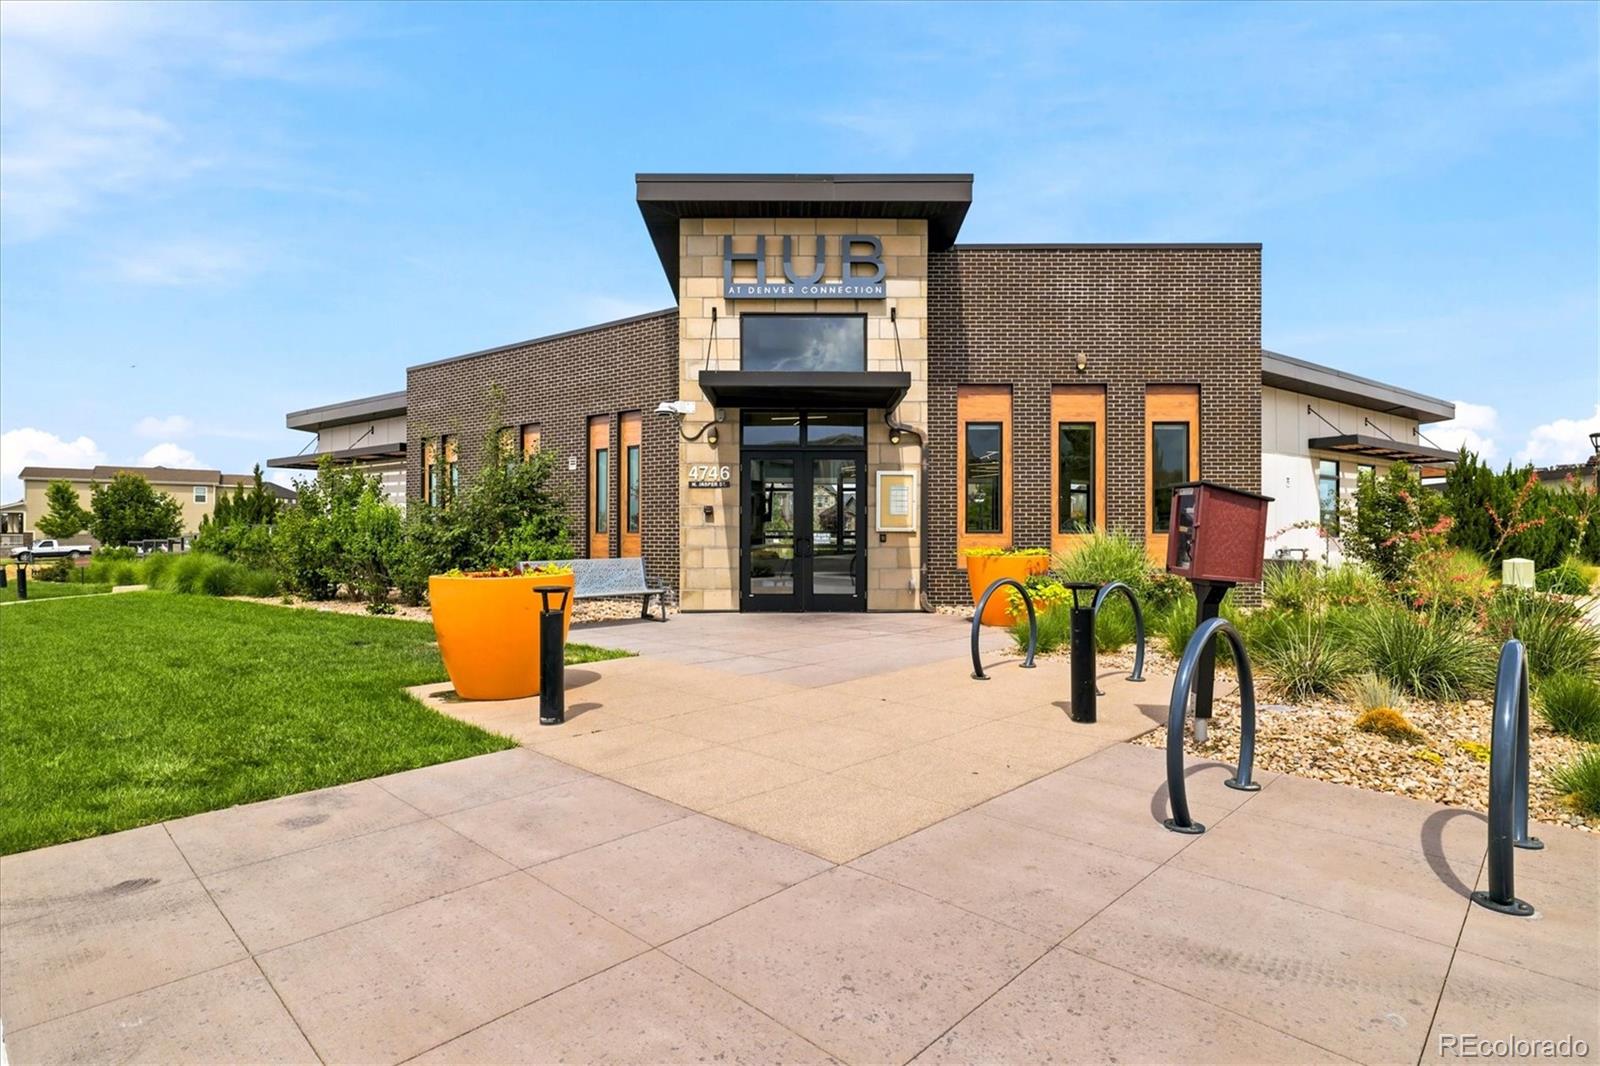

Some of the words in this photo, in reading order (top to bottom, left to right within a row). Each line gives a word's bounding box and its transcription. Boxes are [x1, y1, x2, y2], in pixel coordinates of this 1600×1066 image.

[724, 234, 886, 284] HUB
[728, 286, 742, 294] AT
[748, 286, 794, 294] DENVER
[801, 286, 882, 294] CONNECTION
[688, 466, 730, 480] 4746
